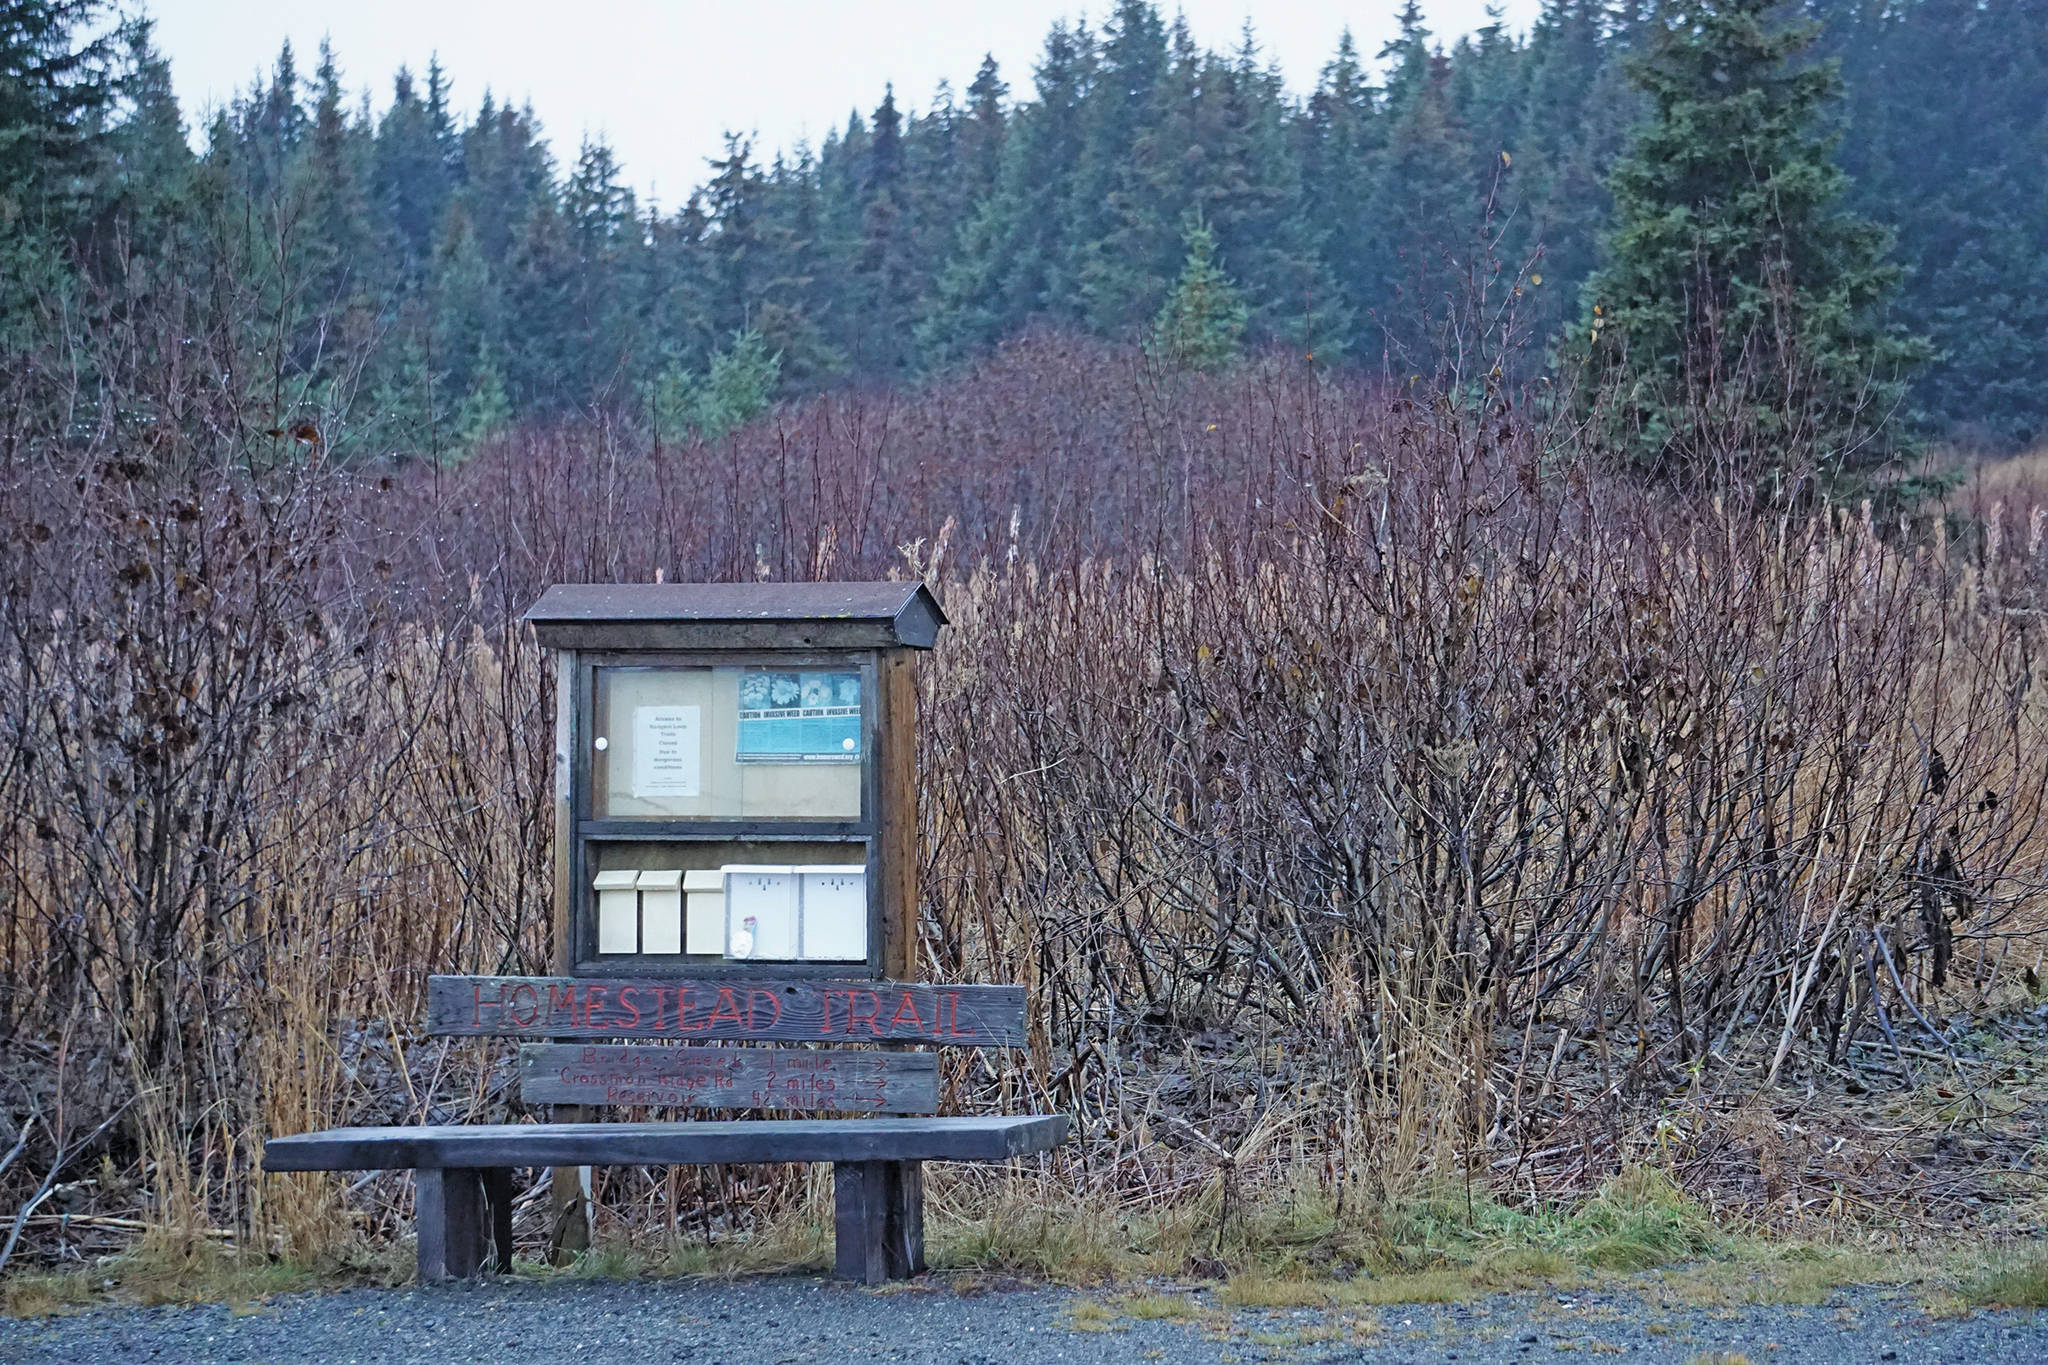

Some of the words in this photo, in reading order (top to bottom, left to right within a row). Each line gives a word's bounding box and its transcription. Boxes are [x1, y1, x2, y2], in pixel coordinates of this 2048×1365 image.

[739, 711, 761, 719] CAUTION
[764, 710, 786, 718] INVASIVE
[786, 709, 800, 717] WEED
[472, 983, 781, 1030] HOMESTEAD
[814, 989, 975, 1036] TRAIL
[582, 1046, 652, 1067] Bridge
[674, 1049, 743, 1068] Creek
[769, 1051, 775, 1070] 1
[786, 1055, 833, 1072] mile
[560, 1066, 646, 1085] Crossman
[657, 1068, 707, 1090] Ridge
[714, 1067, 734, 1089] Rd
[767, 1071, 777, 1090] 2
[786, 1073, 836, 1092] miles
[607, 1086, 696, 1105] Reservoir
[785, 1092, 835, 1109] miles
